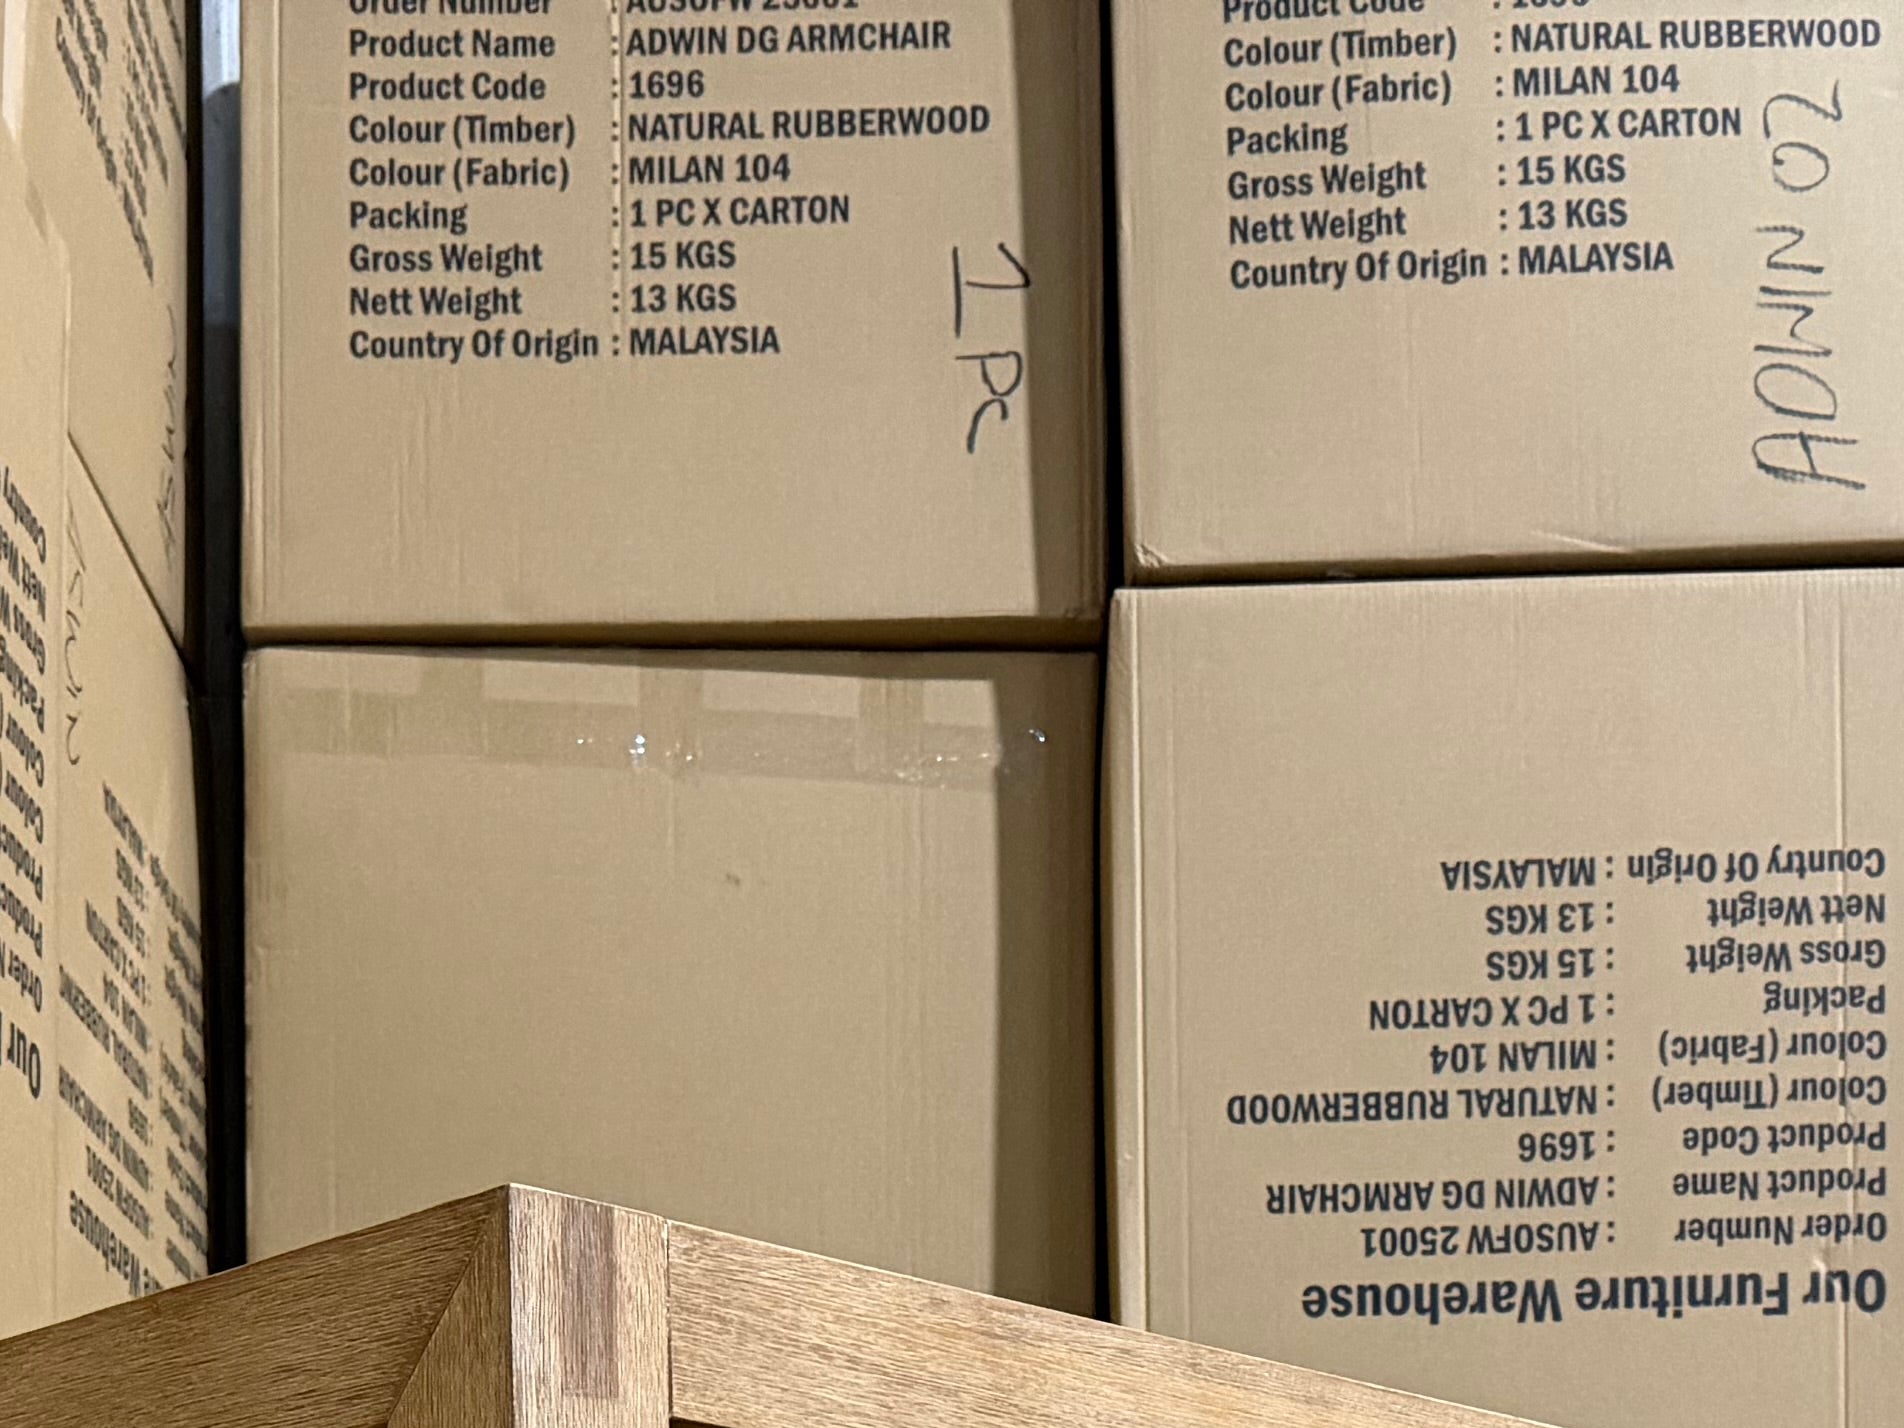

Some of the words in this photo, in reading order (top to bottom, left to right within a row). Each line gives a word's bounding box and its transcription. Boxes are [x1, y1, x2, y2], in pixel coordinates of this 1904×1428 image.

[350, 29, 463, 57] Product
[473, 30, 555, 57] Name
[626, 27, 726, 56] ADWIN
[737, 26, 778, 53] DG
[787, 20, 951, 52] ARMCHAIR
[1224, 37, 1322, 68] Colour
[1331, 26, 1456, 66] (Timber)
[1512, 21, 1651, 52] NATURAL
[1660, 19, 1881, 49] RUBBERWOOD
[350, 72, 463, 100] Product
[472, 72, 545, 100] Code
[630, 70, 704, 99] 1696
[1225, 80, 1324, 112] Colour
[1332, 70, 1451, 111] (Fabric)
[1514, 66, 1610, 97] MILAN
[1624, 64, 1679, 93] 104
[349, 115, 445, 143] Colour
[454, 114, 575, 149] (Timber)
[629, 111, 764, 141] NATURAL
[773, 105, 989, 139] RUBBERWOOD
[349, 157, 445, 186] Colour
[454, 157, 569, 192] (Fabric)
[629, 155, 723, 184] MILAN
[737, 154, 790, 182] 104
[350, 201, 467, 235] Packing
[631, 199, 646, 227] 1
[657, 198, 694, 226] PC
[703, 198, 721, 225] X
[730, 194, 849, 225] CARTON
[1230, 256, 1347, 290] Country
[1356, 251, 1389, 282] Of
[1397, 248, 1487, 285] Origin
[1519, 241, 1674, 275] MALAYSIA
[349, 330, 464, 364] Country
[472, 329, 504, 358] Of
[512, 328, 598, 364] Origin
[630, 326, 780, 356] MALAYSIA
[1440, 857, 1595, 891] MALAYSIA
[1628, 847, 1717, 884] Origin
[1725, 852, 1758, 882] Of
[1767, 844, 1885, 879] Country
[1486, 904, 1547, 935] KGS
[1559, 902, 1594, 933] 13
[1707, 891, 1813, 927] Weight
[1821, 894, 1885, 923] Nett
[1486, 950, 1547, 981] KGS
[1558, 948, 1594, 978] 15
[1686, 937, 1792, 974] Weight
[1800, 939, 1886, 969] Gross
[1370, 997, 1492, 1030] CARTON
[1501, 997, 1520, 1026] X
[1529, 995, 1568, 1025] PC
[1578, 994, 1595, 1023] 1
[1763, 981, 1885, 1016] Packing
[1430, 1044, 1486, 1074] 104
[1499, 1040, 1596, 1071] MILAN
[1659, 1028, 1778, 1066] (Fabric)
[1787, 1030, 1887, 1060] Colour
[7, 1023, 41, 1100] Our
[1227, 1090, 1448, 1124] RUBBERWOOD
[1457, 1085, 1596, 1118] NATURAL
[1652, 1073, 1778, 1112] (Timber)
[1787, 1076, 1886, 1106] Colour
[1519, 1131, 1595, 1162] 1696
[1683, 1126, 1758, 1156] Code
[1768, 1121, 1886, 1153] Product
[1266, 1181, 1434, 1214] ARMCHAIR
[1442, 1180, 1484, 1210] DG
[1496, 1176, 1599, 1208] ADWIN
[1673, 1172, 1758, 1200] Name
[1768, 1167, 1886, 1199] Product
[1361, 1226, 1458, 1257] 25001
[1467, 1221, 1599, 1254] AUSOFW
[1674, 1216, 1793, 1246] Number
[1801, 1212, 1887, 1243] Order
[1302, 1280, 1562, 1325] Warehouse
[1575, 1272, 1788, 1319] Furniture
[1802, 1269, 1886, 1313] Our
